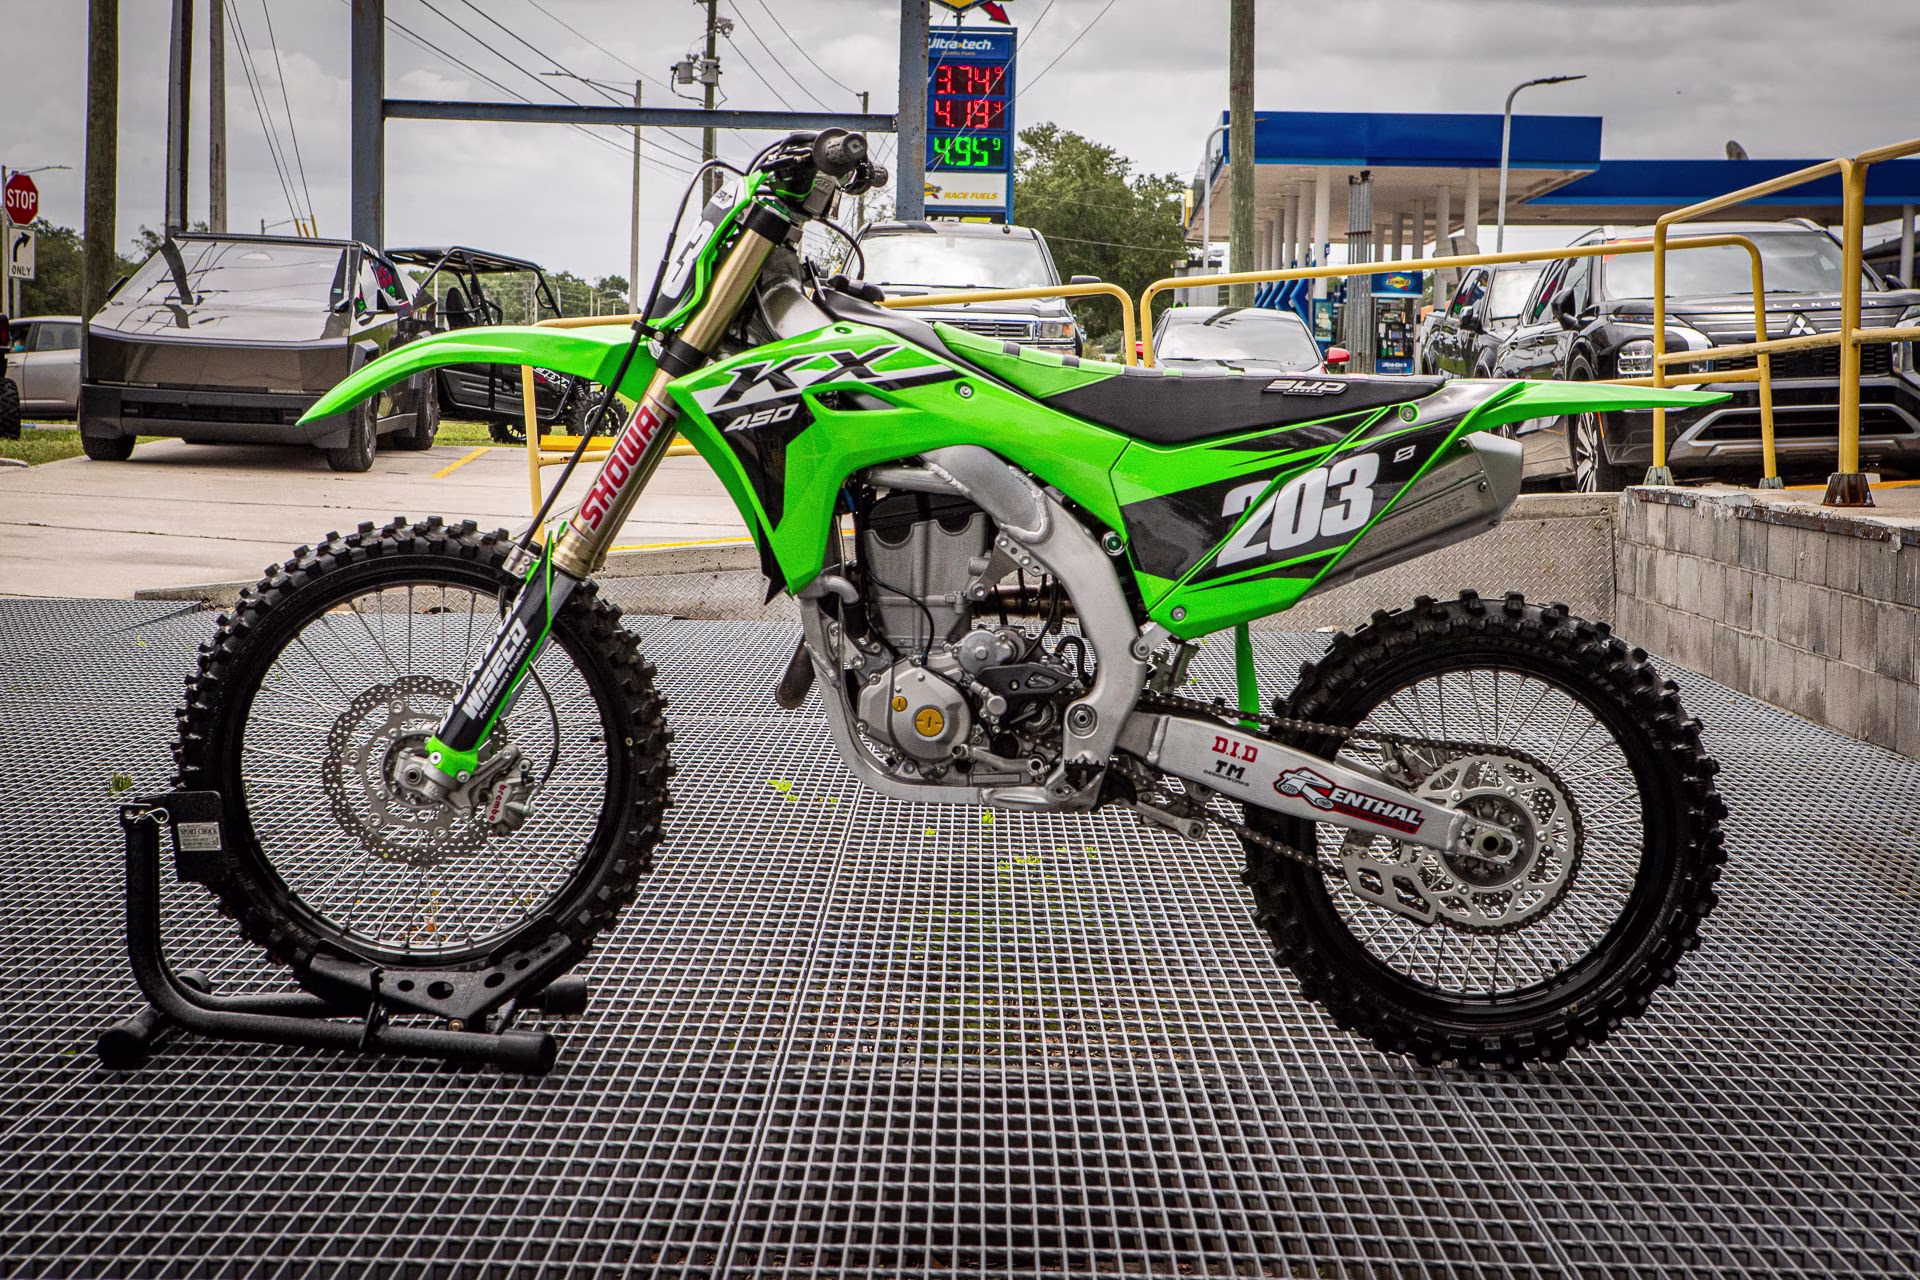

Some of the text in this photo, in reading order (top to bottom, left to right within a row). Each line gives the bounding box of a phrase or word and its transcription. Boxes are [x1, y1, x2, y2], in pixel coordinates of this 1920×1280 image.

[6, 188, 37, 211] STOP
[944, 192, 998, 200] RACE FUELS
[11, 265, 32, 277] ONLY
[712, 345, 905, 408] KX
[724, 404, 799, 432] 450
[580, 405, 661, 531] SHOWA
[1216, 452, 1380, 567] 203
[1212, 736, 1258, 763] D.I.D
[1215, 759, 1247, 780] TM
[489, 784, 507, 821] brembo
